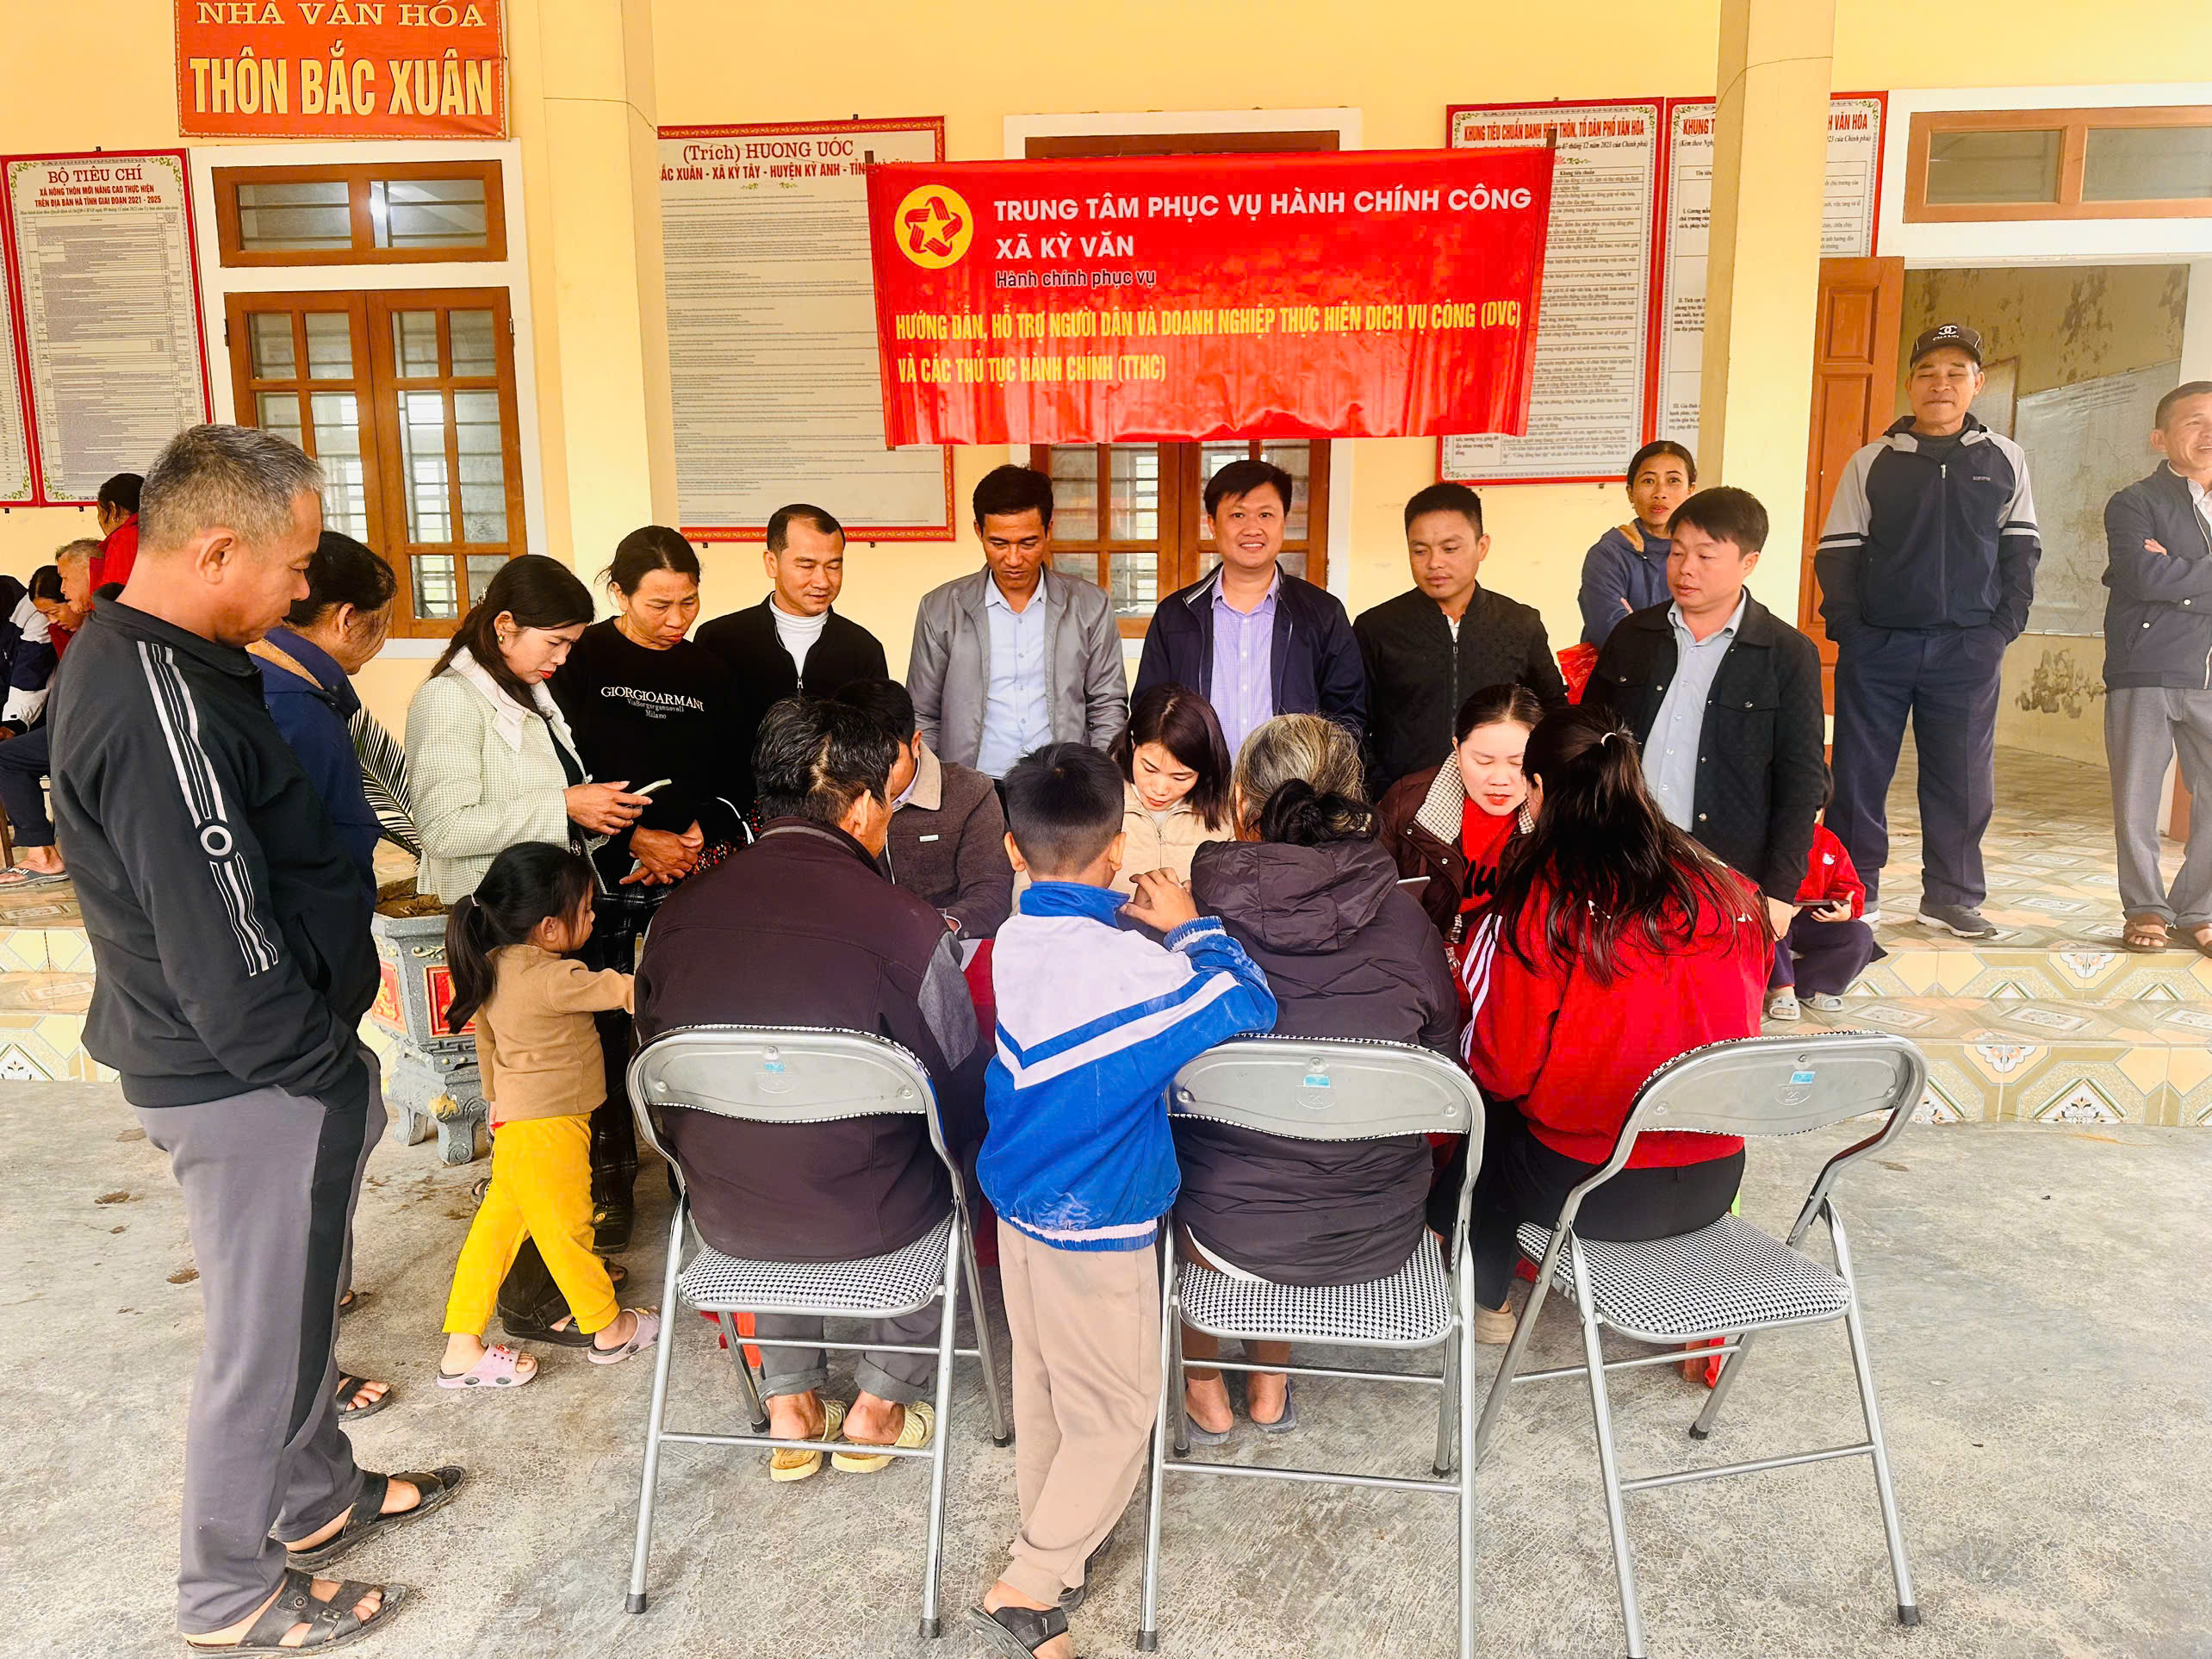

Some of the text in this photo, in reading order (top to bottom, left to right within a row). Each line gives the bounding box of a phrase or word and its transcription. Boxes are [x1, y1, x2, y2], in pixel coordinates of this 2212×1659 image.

[196, 0, 487, 27] NHÀ VĂN HÓA
[189, 40, 493, 115] THÔN BẮC XUÂN
[1464, 125, 1485, 141] KHUNG
[1525, 123, 1542, 139] DANH
[1618, 117, 1630, 135] VĂN
[1682, 119, 1709, 134] KHUNG
[1835, 111, 1850, 130] VĂN
[1852, 110, 1867, 130] HÓA
[683, 145, 740, 164] (Trích)
[47, 164, 143, 186] BỘ TIÊU CHÍ
[660, 164, 674, 181] ẮC
[676, 165, 703, 181] XUÂN
[712, 164, 725, 179] XÃ
[743, 163, 760, 178] TÂY
[770, 162, 802, 180] HUYỆN
[820, 163, 840, 177] ANH
[849, 158, 866, 175] TỈN
[48, 186, 65, 196] NÔNG
[66, 185, 81, 196] THÔN
[112, 185, 123, 194] CAO
[98, 196, 109, 205] GIAI
[128, 196, 141, 204] 2021
[147, 196, 161, 204] 2025
[994, 199, 1078, 221] TRUNG
[1086, 193, 1140, 219] TÂM
[1148, 195, 1220, 224] PHỤC
[1227, 194, 1262, 221] VỤ
[1271, 187, 1345, 214] HÀNH
[1353, 183, 1439, 212] CHÍNH
[1448, 183, 1532, 210] CÔNG
[996, 231, 1134, 259] XÃ KỲ VĂN
[996, 269, 1156, 289] Hành chính phục vụ
[896, 310, 948, 339] HƯỚNG
[952, 305, 988, 342] DẪN,
[992, 304, 1012, 339] HỖ
[1016, 310, 1045, 344] TRỢ
[1049, 306, 1096, 338] NGƯỜI
[1101, 306, 1133, 337] DÂN
[1137, 306, 1157, 336] VÀ
[1161, 310, 1213, 335] DOANH
[1218, 304, 1275, 339] NGHIỆP
[1280, 303, 1320, 338] THỰC
[1324, 301, 1360, 337] HIỆN
[1365, 304, 1402, 337] DỊCH
[1407, 304, 1427, 335] VỤ
[1432, 299, 1475, 329] CÔNG
[1481, 300, 1520, 330] (DVC)
[898, 349, 1165, 388] VÀ CÁC THỦ TỤC HÀNH CHÍNH (TTHC)
[645, 709, 667, 719] Milano
